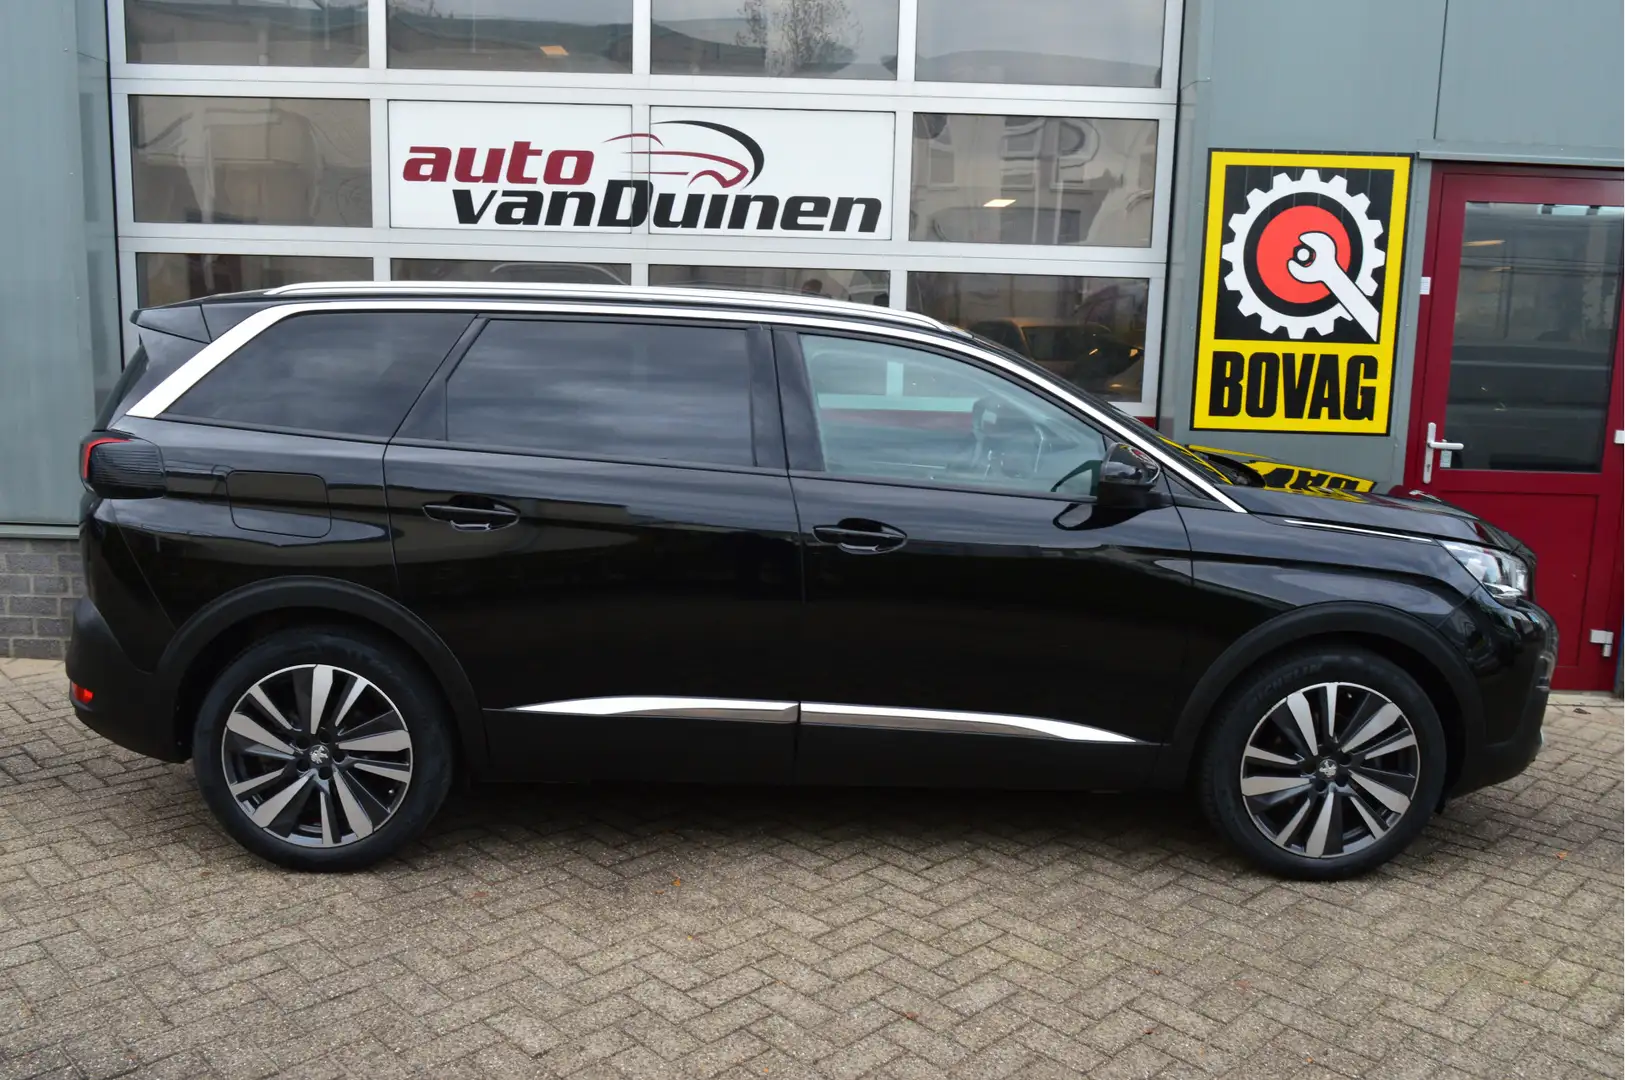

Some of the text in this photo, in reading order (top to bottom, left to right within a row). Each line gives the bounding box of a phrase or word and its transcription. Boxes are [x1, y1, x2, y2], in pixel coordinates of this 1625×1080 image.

[403, 141, 594, 185] auto
[452, 179, 882, 233] vanDuinen
[1208, 350, 1379, 421] BOVAG
